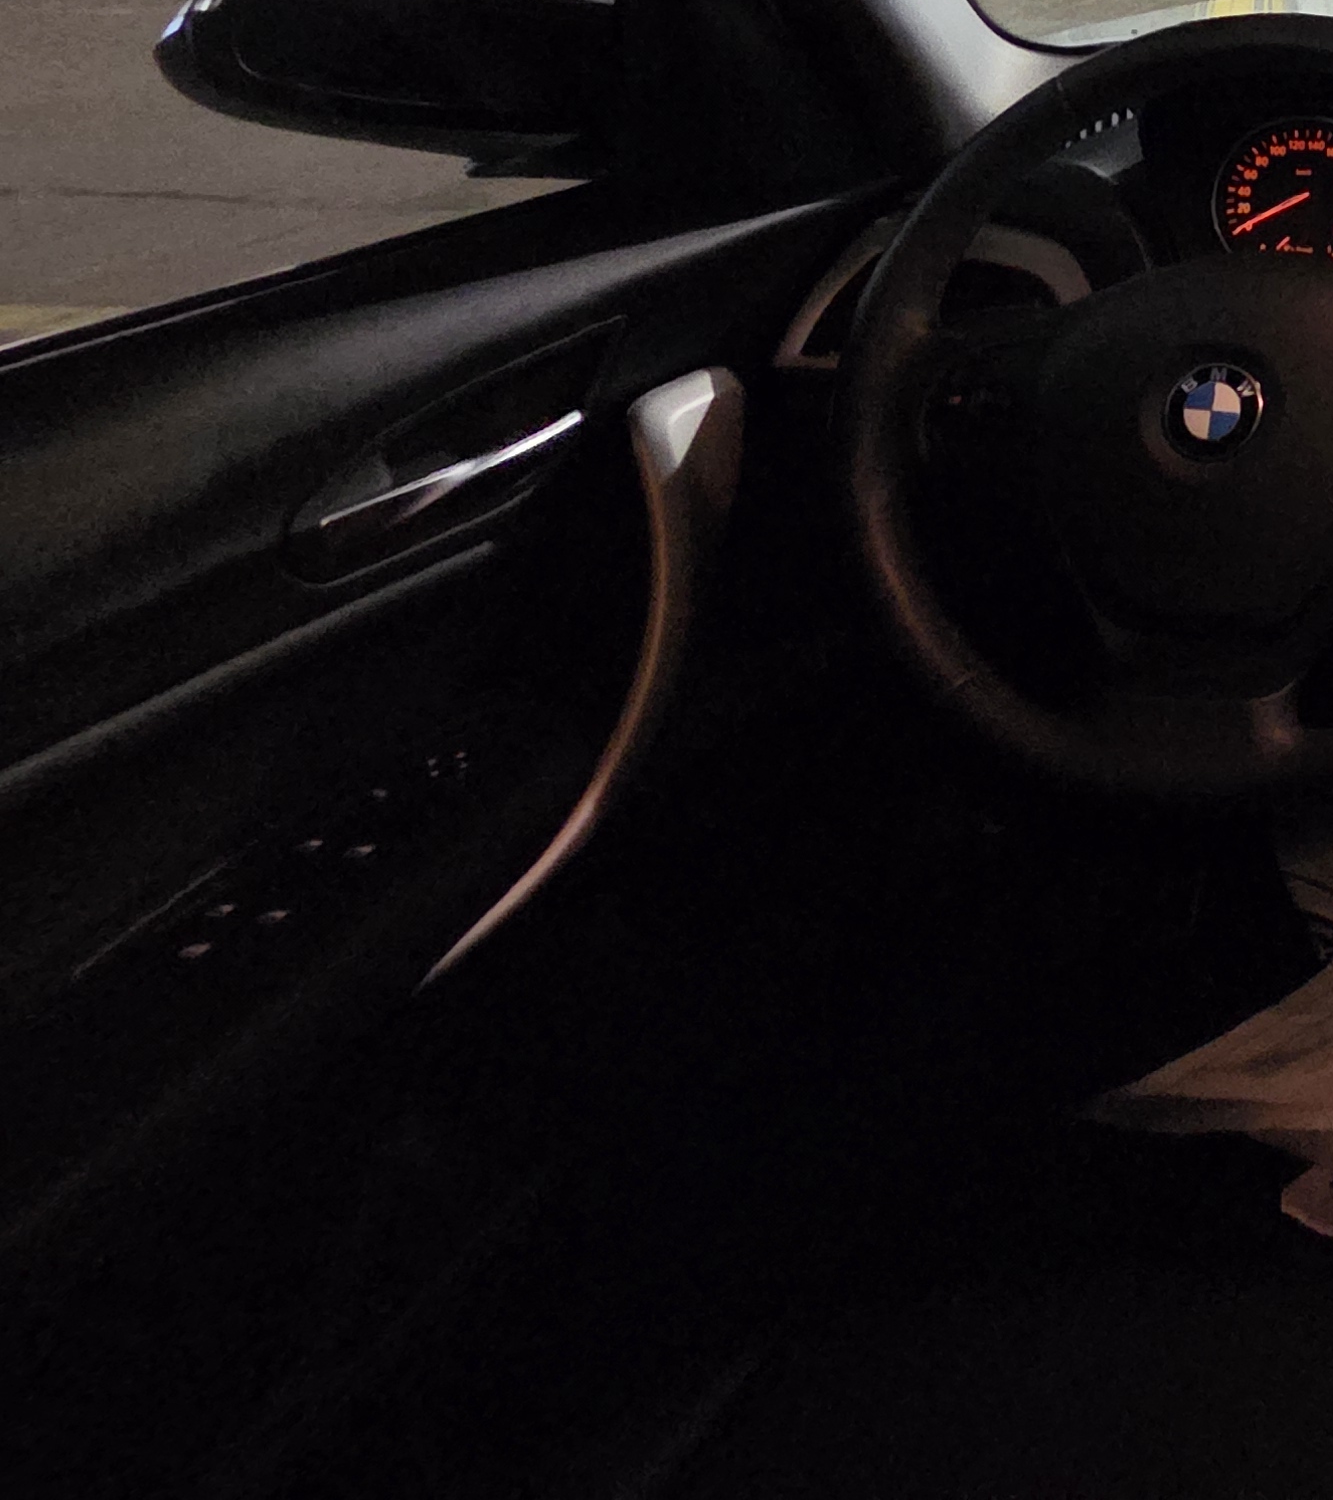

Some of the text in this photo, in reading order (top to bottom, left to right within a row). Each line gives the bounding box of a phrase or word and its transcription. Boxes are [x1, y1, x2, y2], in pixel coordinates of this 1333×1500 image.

[1269, 145, 1287, 157] 100
[1288, 140, 1305, 151] 120
[1308, 140, 1326, 151] 140
[1243, 169, 1258, 180] 60
[1237, 185, 1252, 197] 40
[1237, 202, 1251, 214] 20
[1181, 366, 1255, 398] BMW
